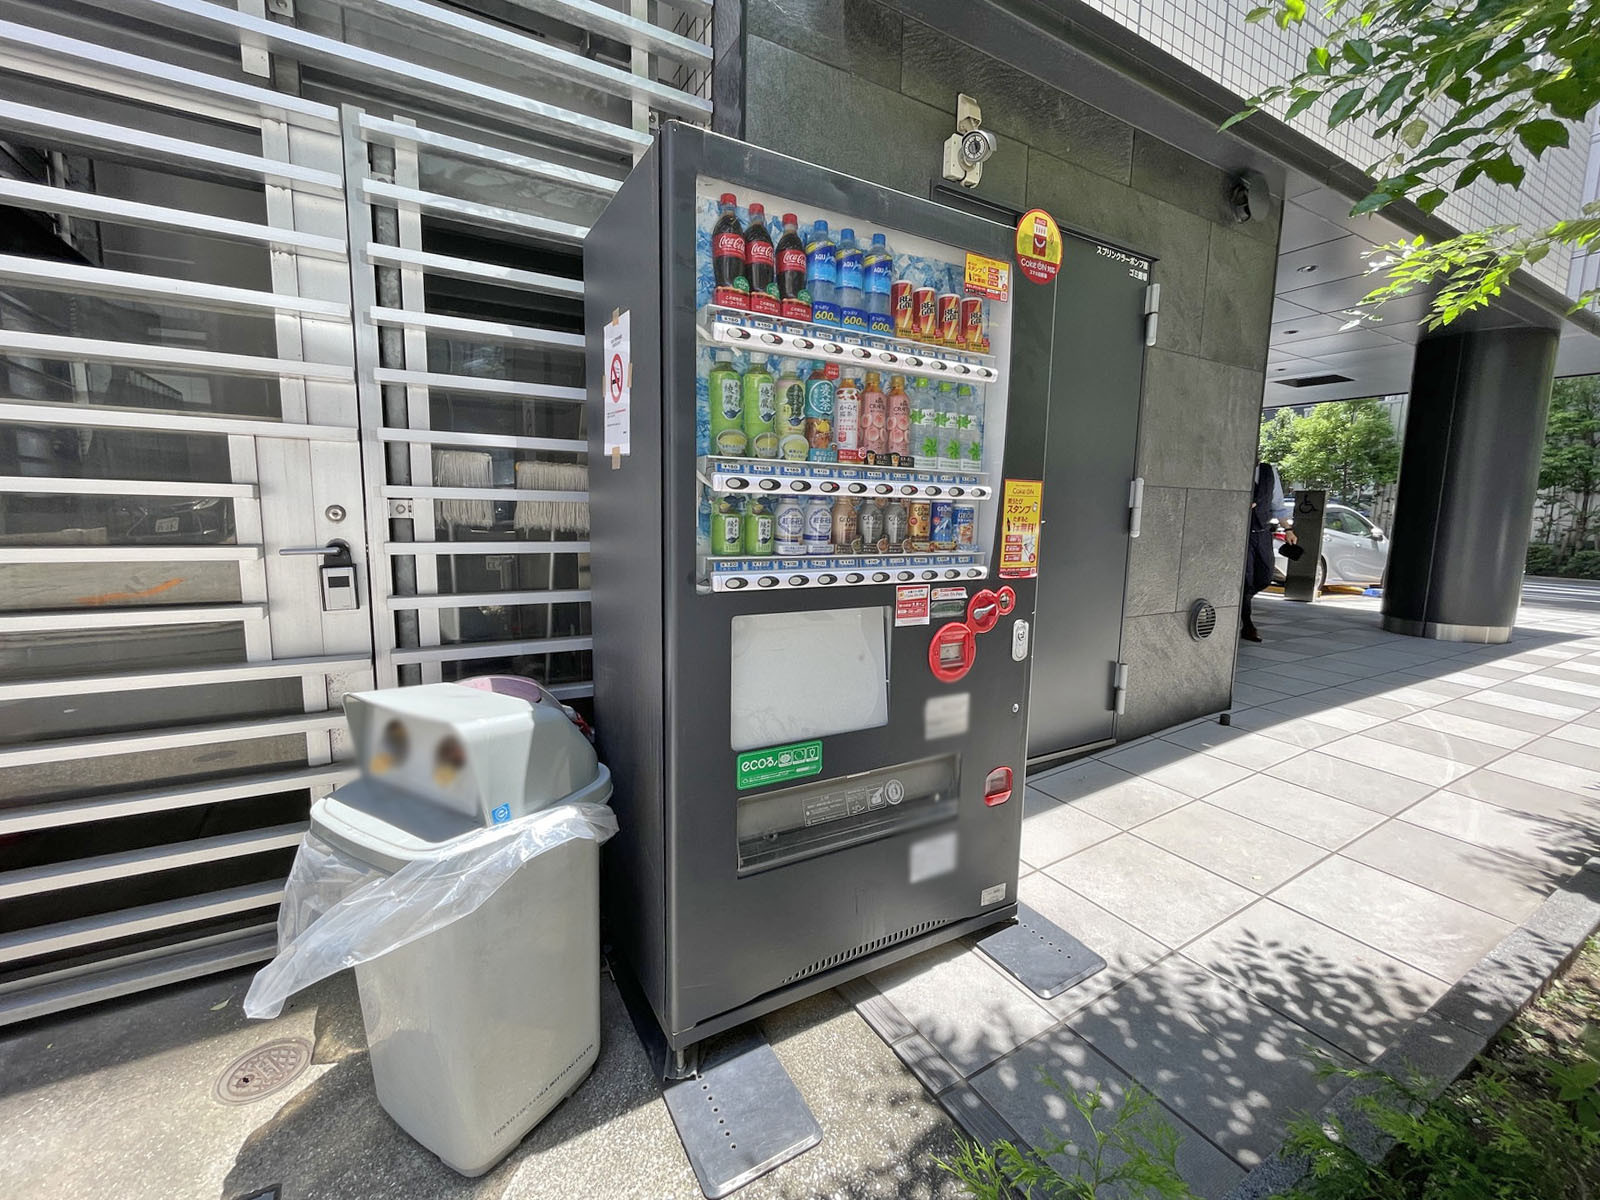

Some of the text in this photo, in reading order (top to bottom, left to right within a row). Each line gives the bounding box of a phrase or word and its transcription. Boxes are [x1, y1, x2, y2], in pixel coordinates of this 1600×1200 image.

[820, 384, 831, 411] 麦茶
[1007, 505, 1032, 514] スタンプ
